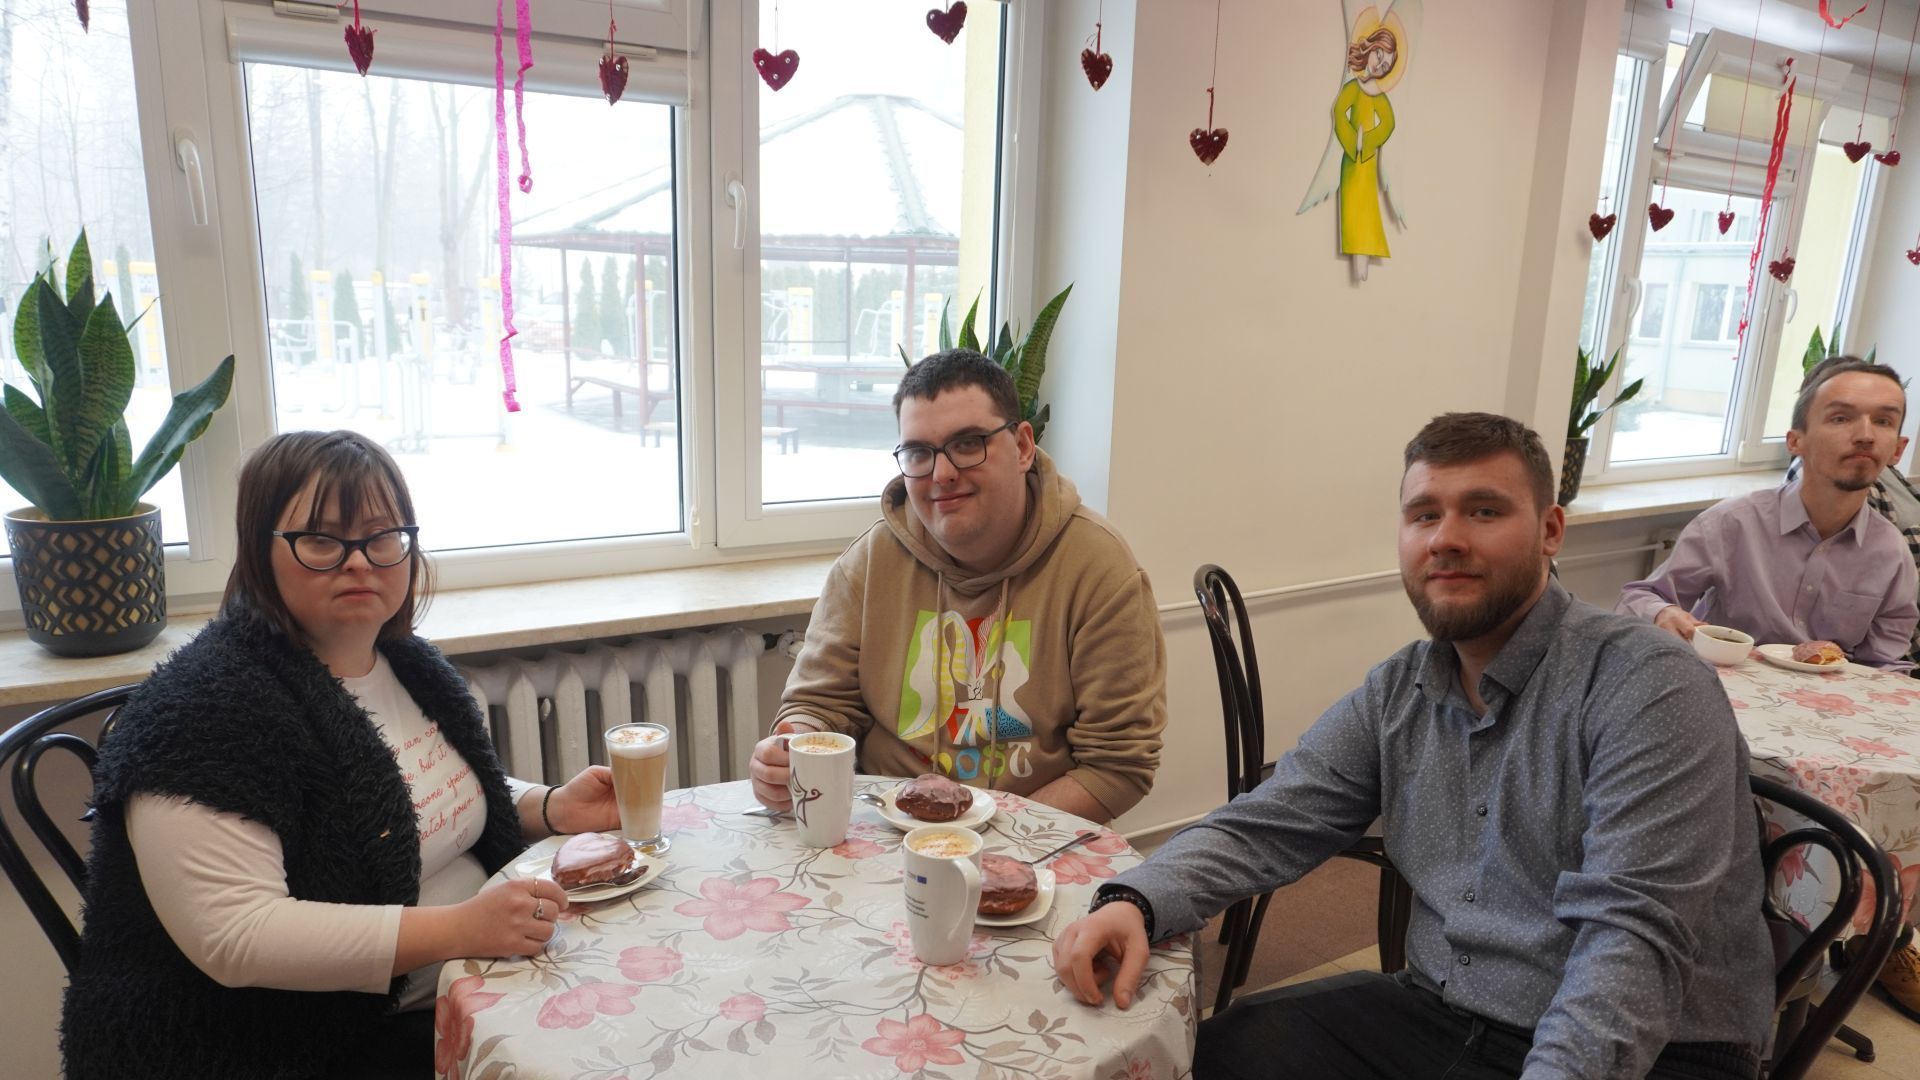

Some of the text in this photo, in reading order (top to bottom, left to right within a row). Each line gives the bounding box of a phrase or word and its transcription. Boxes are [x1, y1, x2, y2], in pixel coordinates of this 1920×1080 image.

[418, 751, 436, 773] but
[418, 796, 475, 841] atch your
